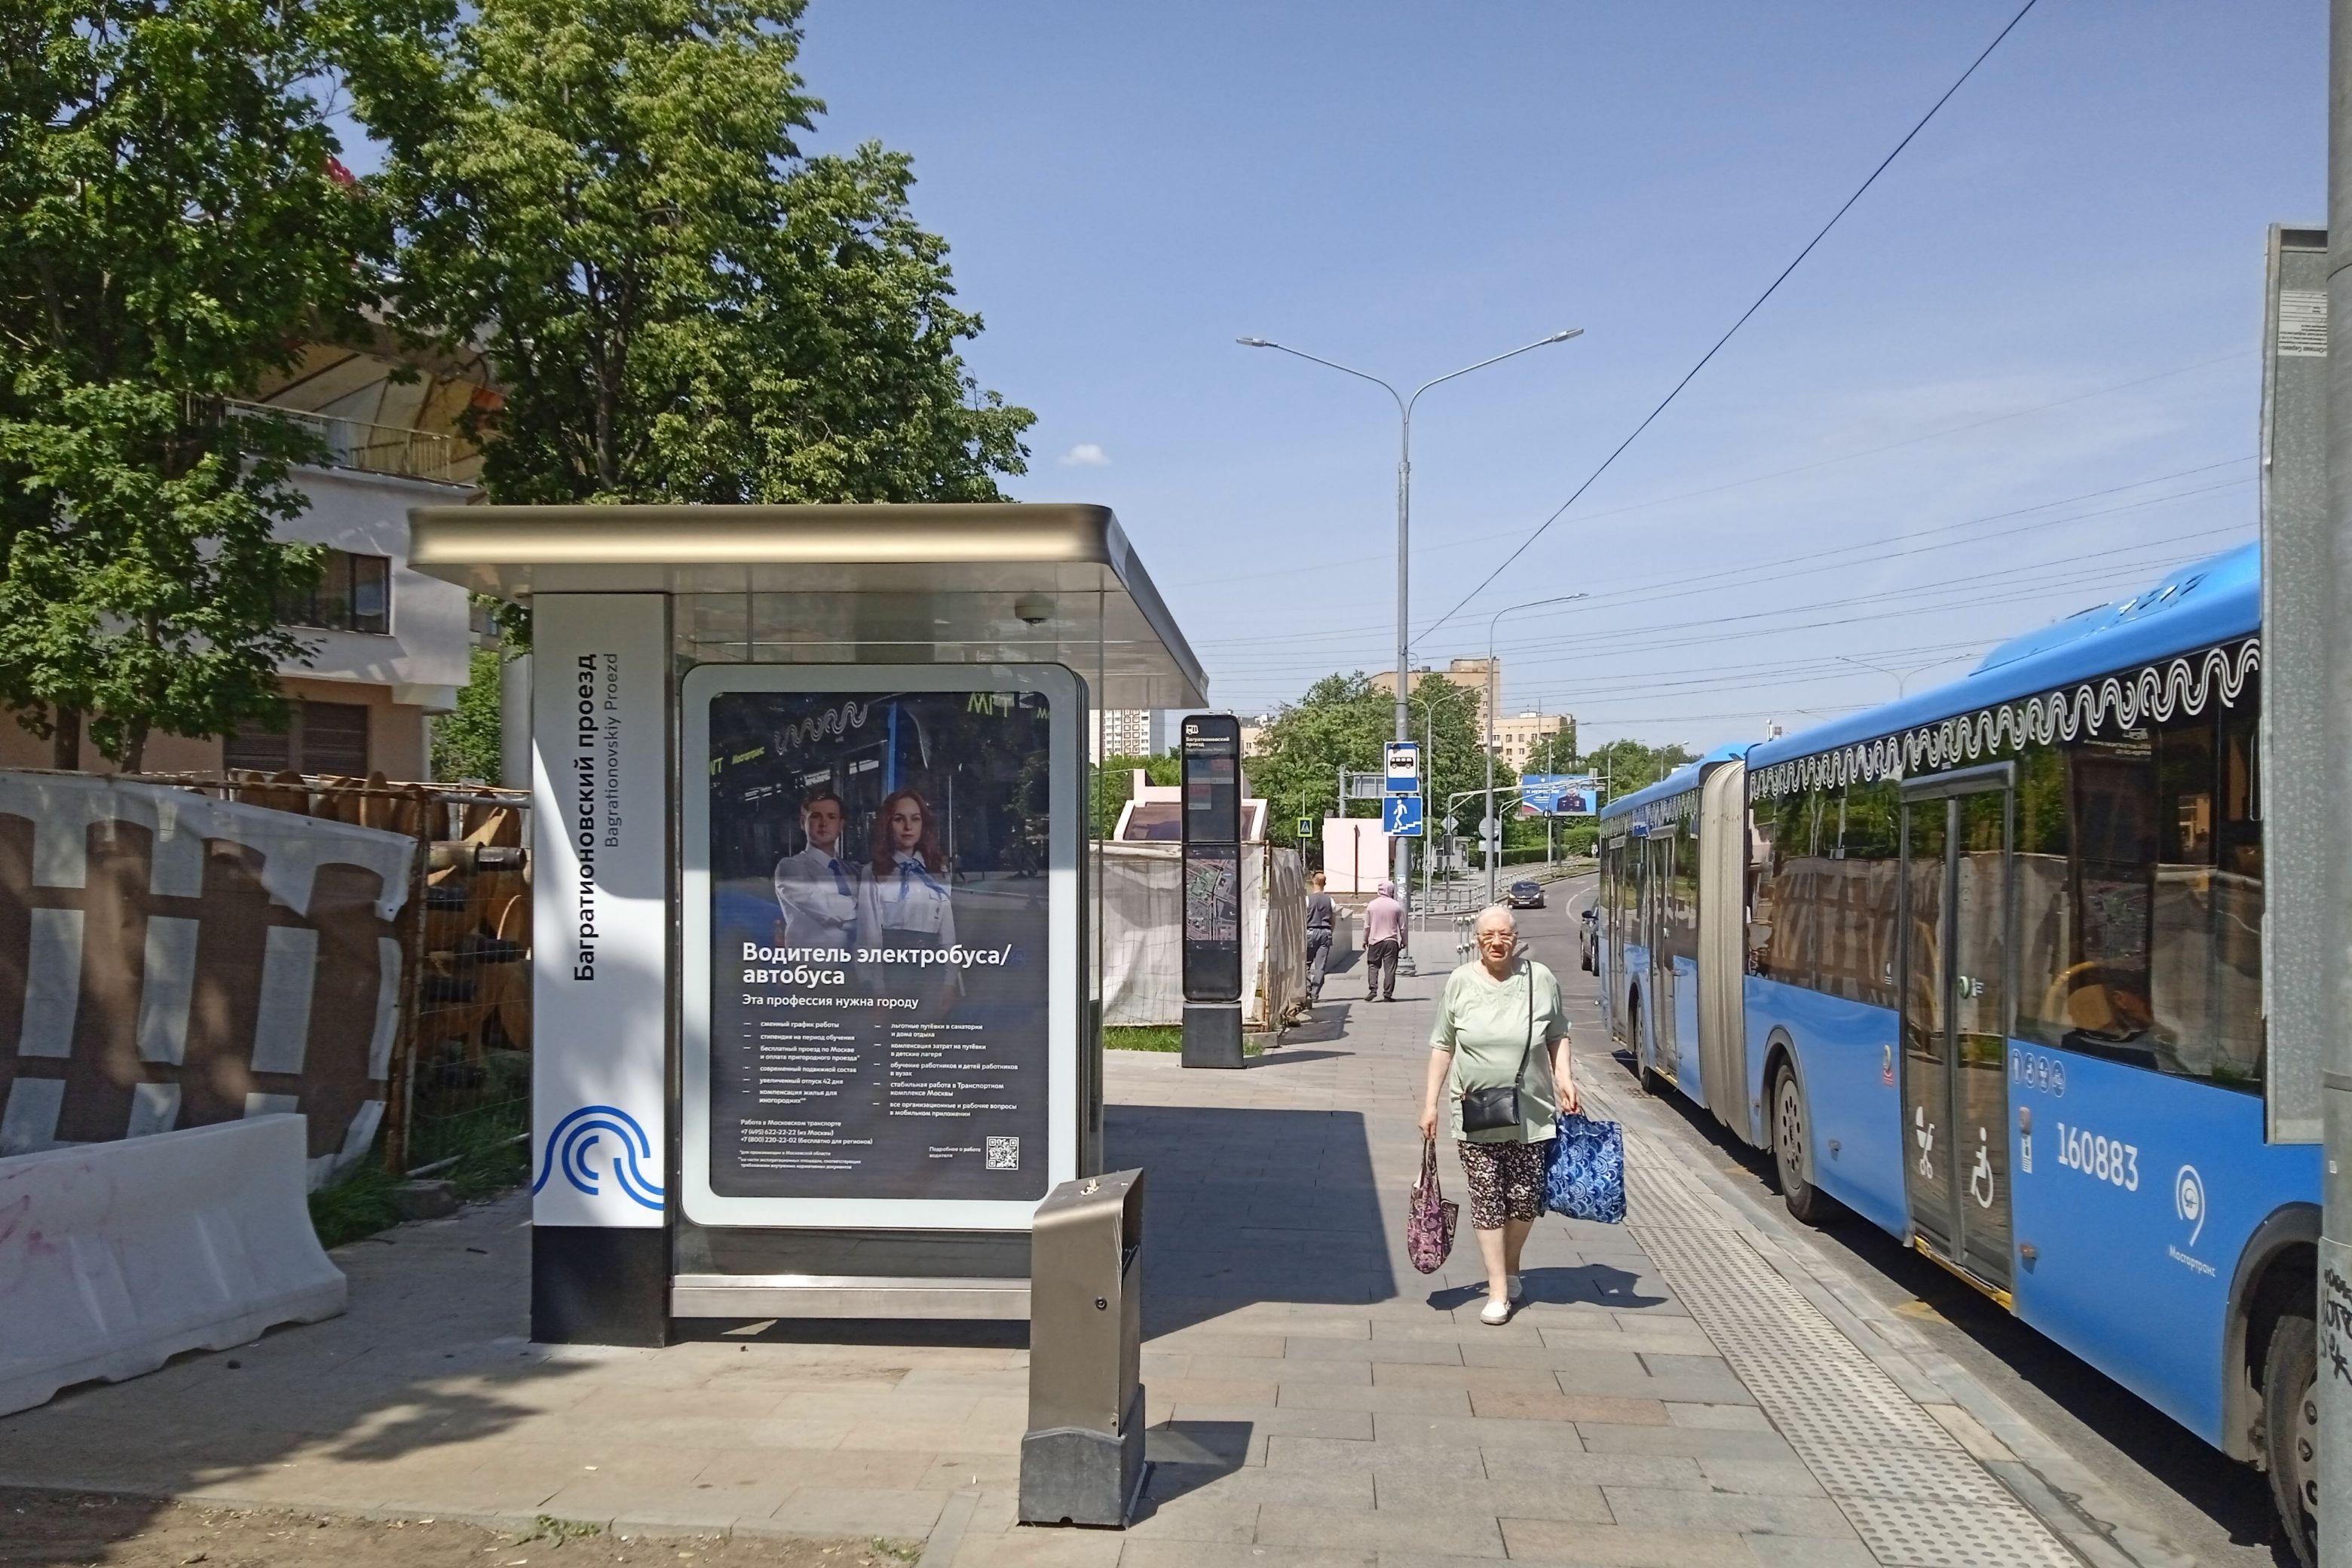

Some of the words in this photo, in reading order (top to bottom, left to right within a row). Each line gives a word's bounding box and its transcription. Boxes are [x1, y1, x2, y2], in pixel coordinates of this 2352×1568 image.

[578, 654, 599, 749] проезд
[605, 653, 618, 711] Proezd
[605, 714, 622, 847] Bagrationovskiy
[574, 756, 599, 981] Багратионовский
[743, 942, 852, 963] Водитель
[856, 944, 1012, 968] электробуса/
[743, 965, 845, 988] автобуса
[742, 994, 763, 1005] Эта
[767, 994, 833, 1007] профессия
[835, 997, 874, 1008] нужна
[877, 997, 919, 1009] городу
[2057, 1122, 2139, 1192] 160883
